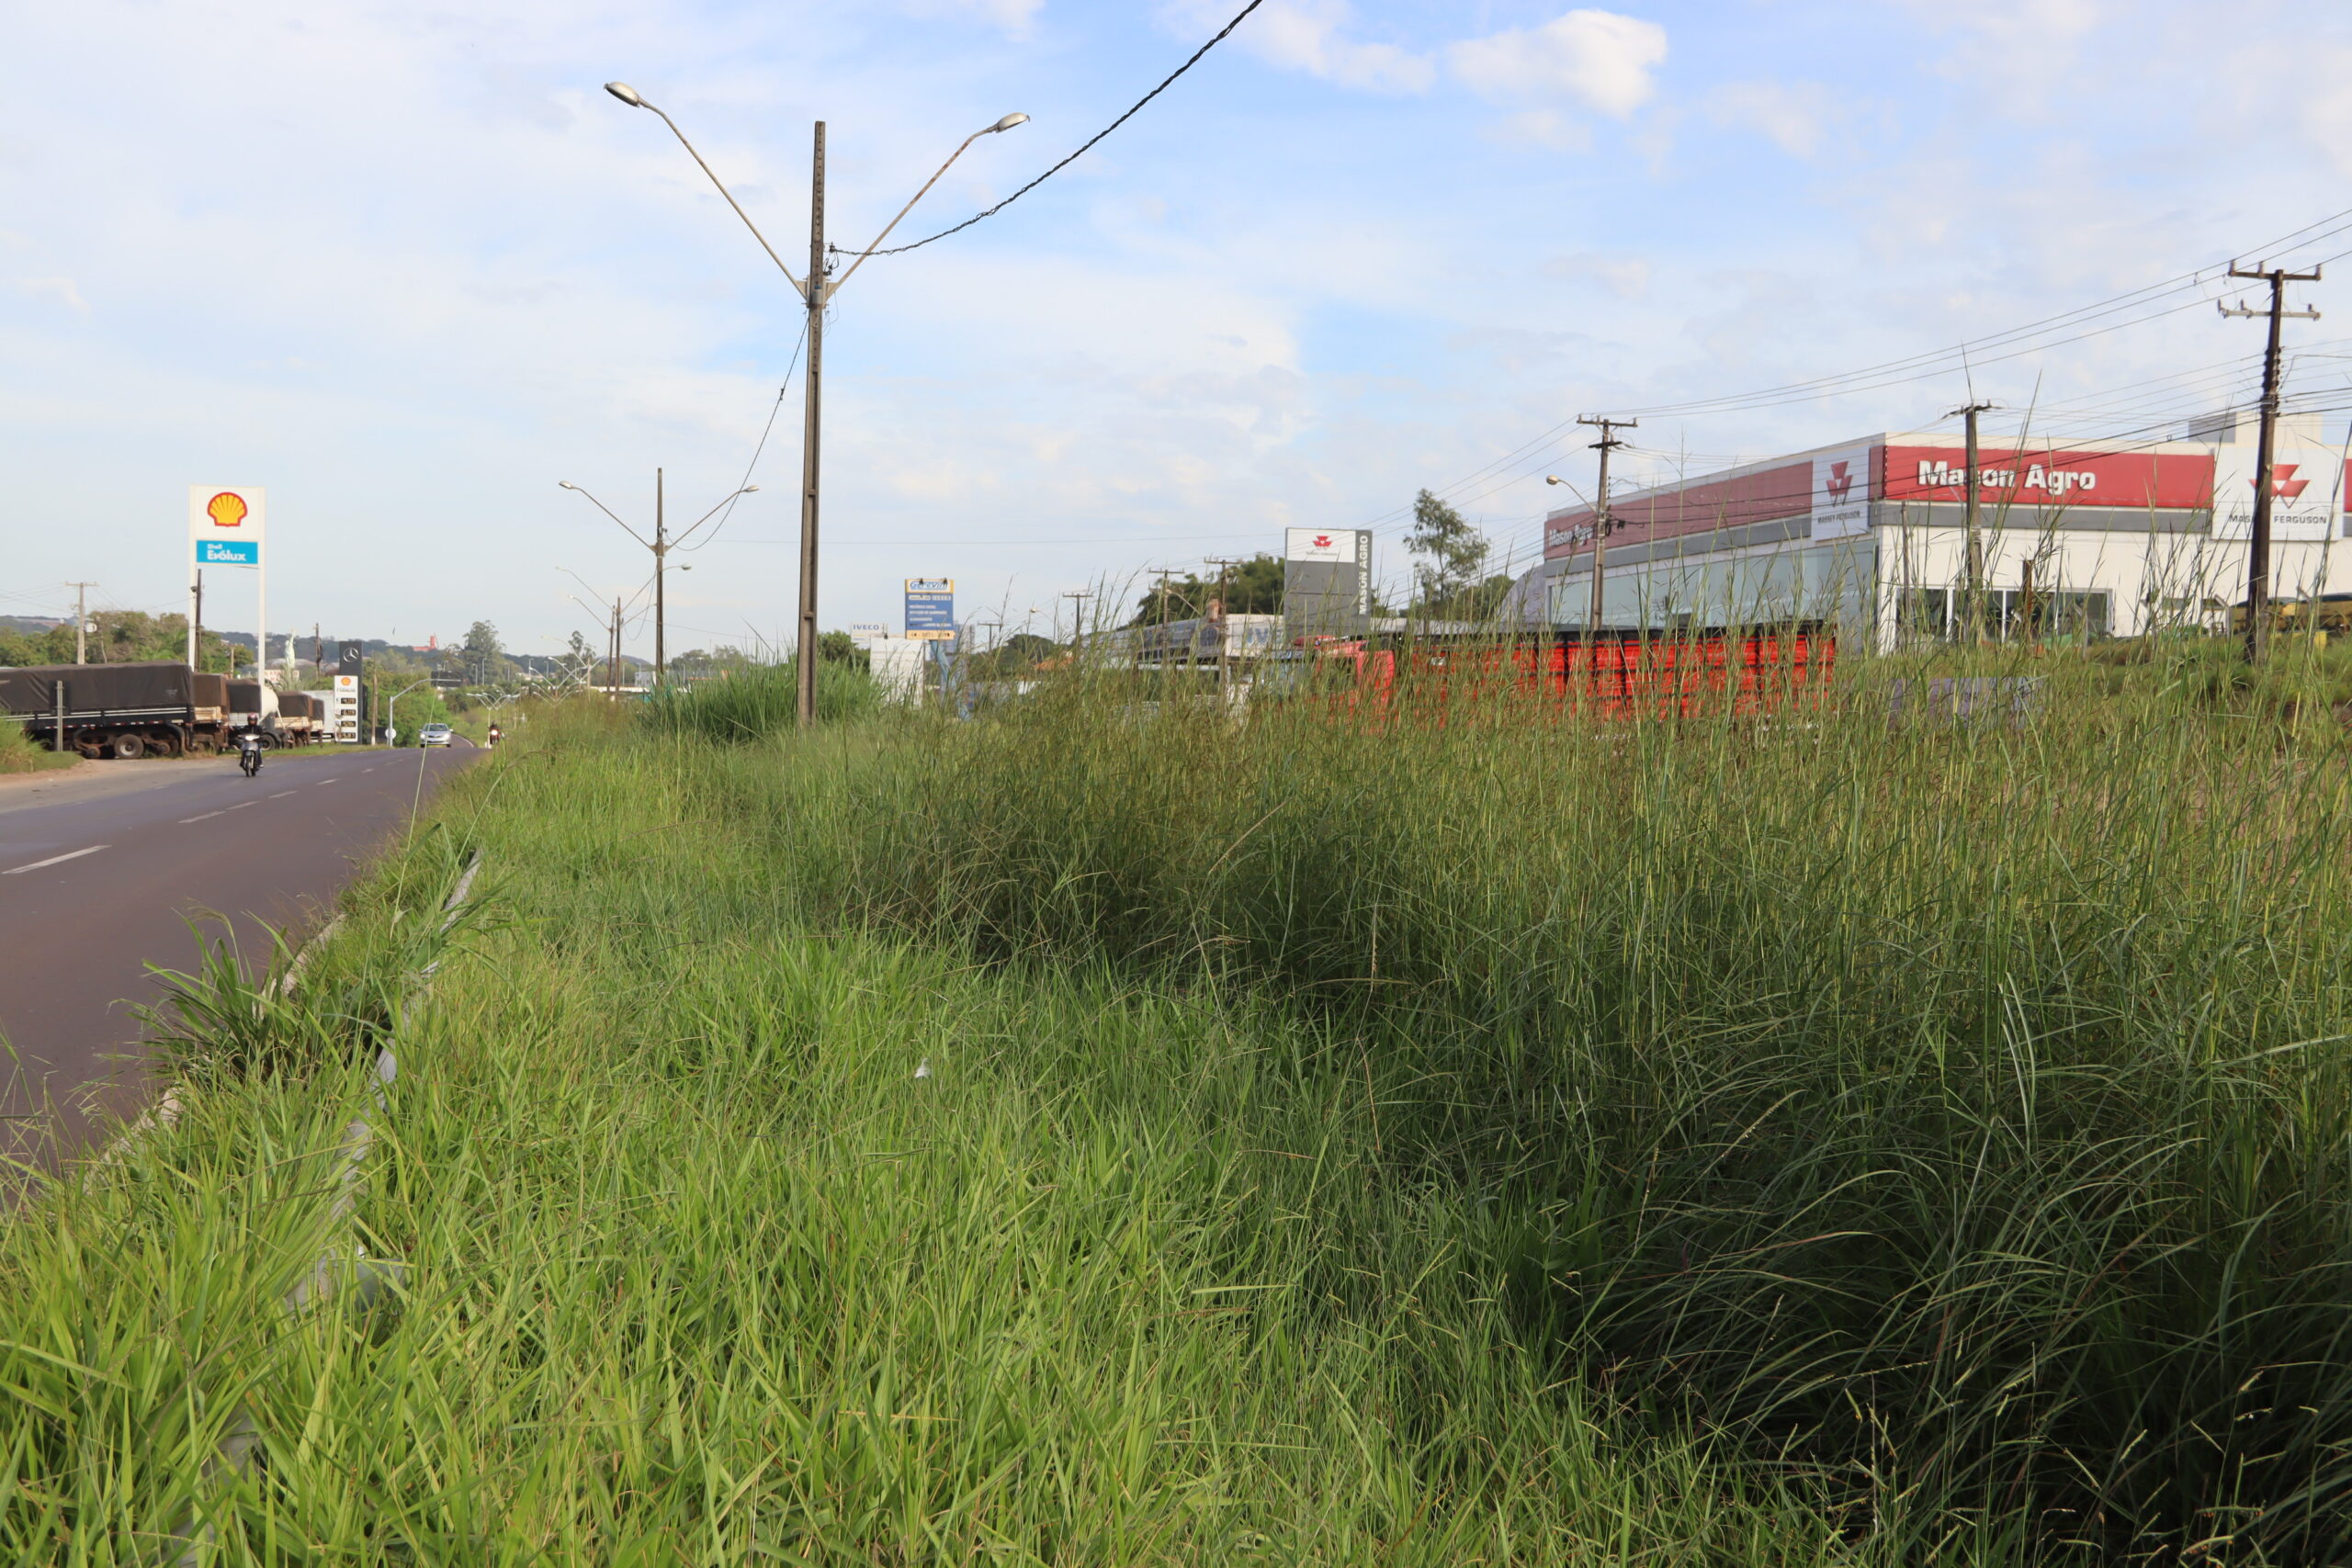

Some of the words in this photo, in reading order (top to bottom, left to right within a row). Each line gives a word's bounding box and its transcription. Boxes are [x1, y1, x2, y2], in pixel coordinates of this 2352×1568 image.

[1918, 460, 2015, 488] Maon
[2024, 464, 2096, 495] Agro
[2274, 515, 2326, 524] FERGUSON
[1360, 535, 1368, 570] AGRO
